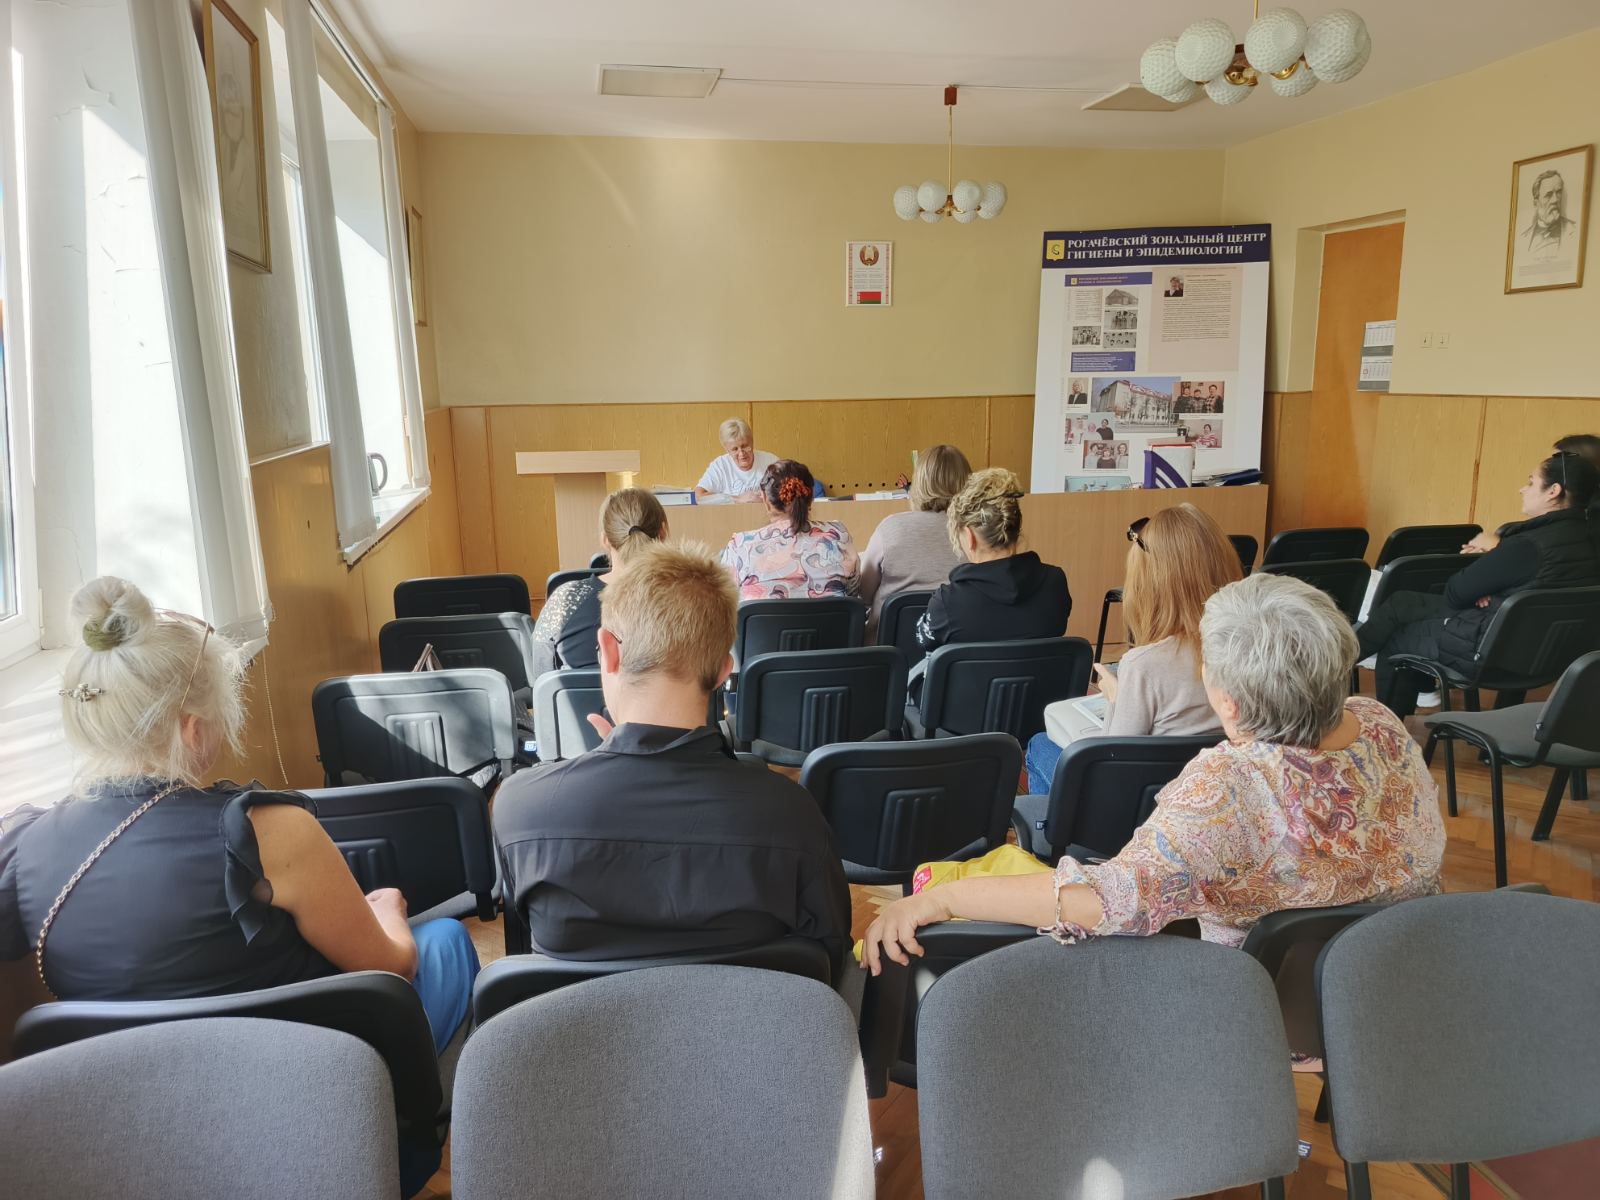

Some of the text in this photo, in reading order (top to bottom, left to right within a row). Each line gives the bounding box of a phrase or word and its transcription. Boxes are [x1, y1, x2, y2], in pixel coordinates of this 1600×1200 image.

[1068, 233, 1266, 248] РОГАЧЁВСКИЙ ЗОНАЛЬНЫЙ ЦЕНТР
[1067, 246, 1243, 260] ГИГИЕНЫ И ЭПИДЕМИОЛОГИИ
